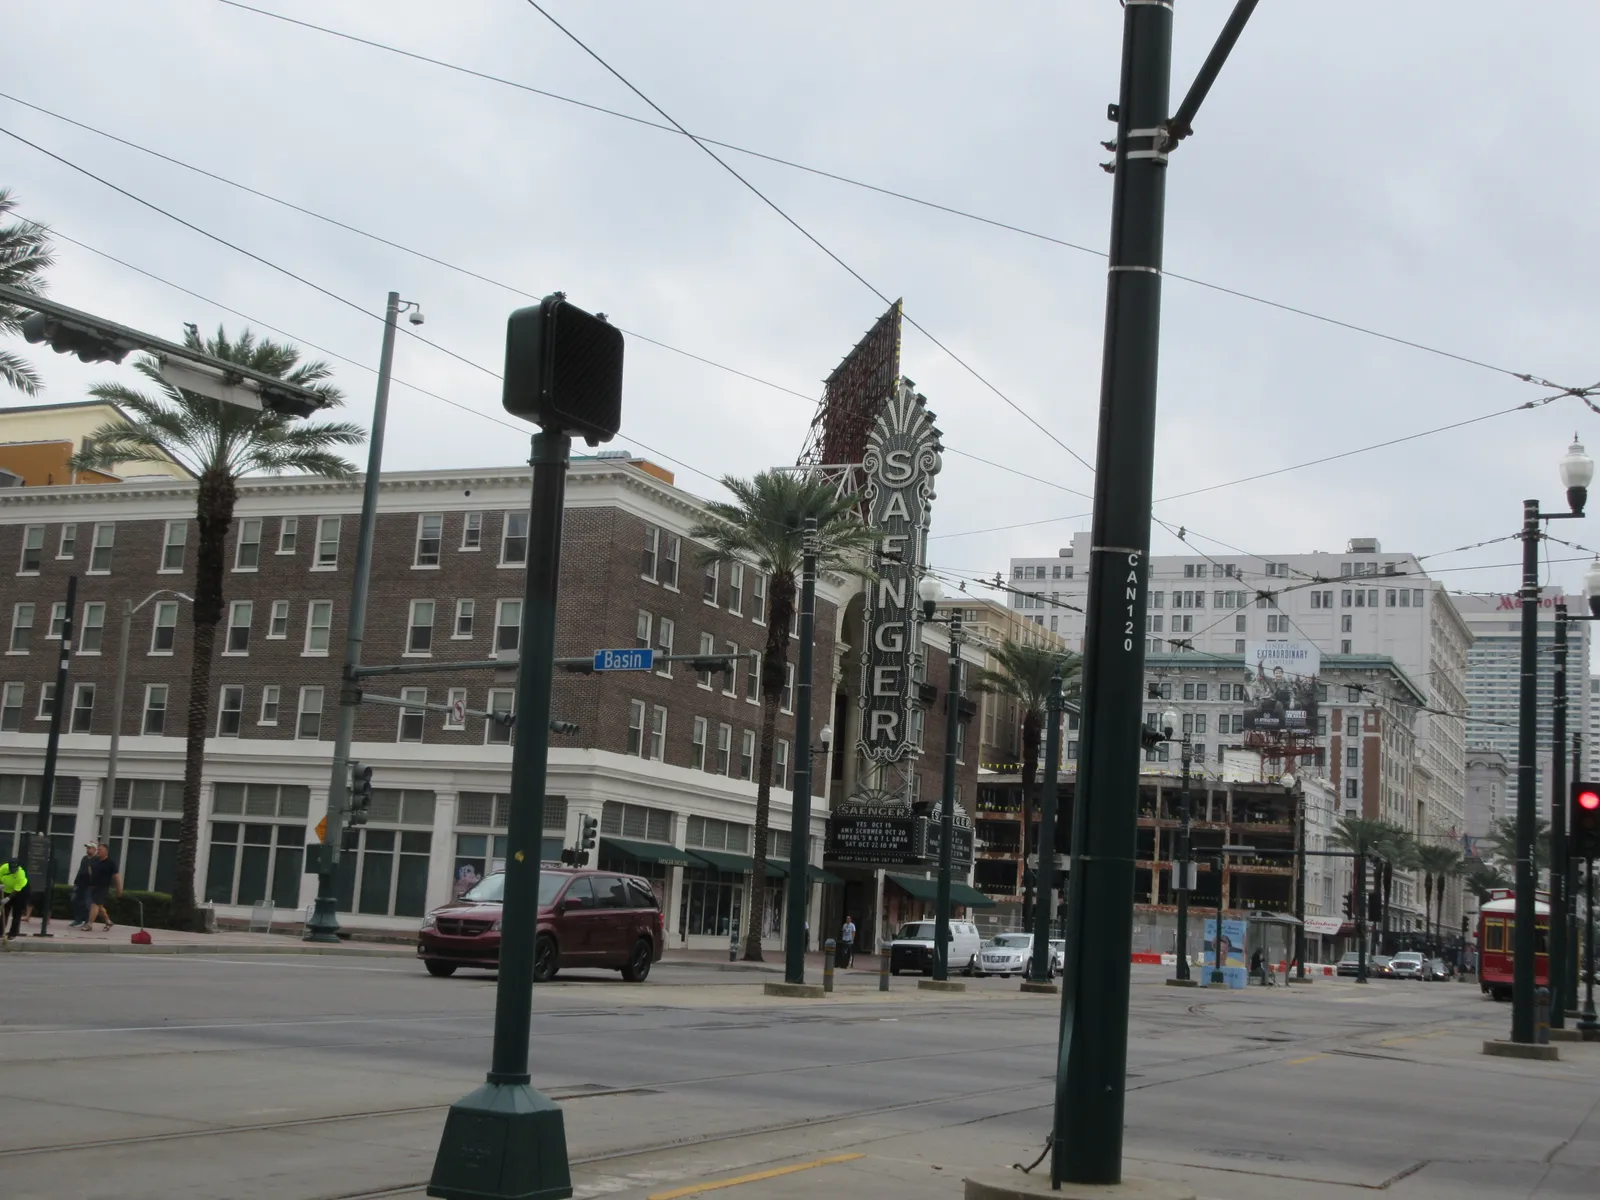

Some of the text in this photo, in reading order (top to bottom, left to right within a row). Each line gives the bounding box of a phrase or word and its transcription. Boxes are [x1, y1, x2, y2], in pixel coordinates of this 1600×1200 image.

[870, 450, 912, 741] SAENGER
[1124, 553, 1138, 652] CAN120
[604, 650, 642, 669] Basin
[1257, 649, 1308, 660] EXTRAORDINARY
[841, 806, 906, 817] SAENGER
